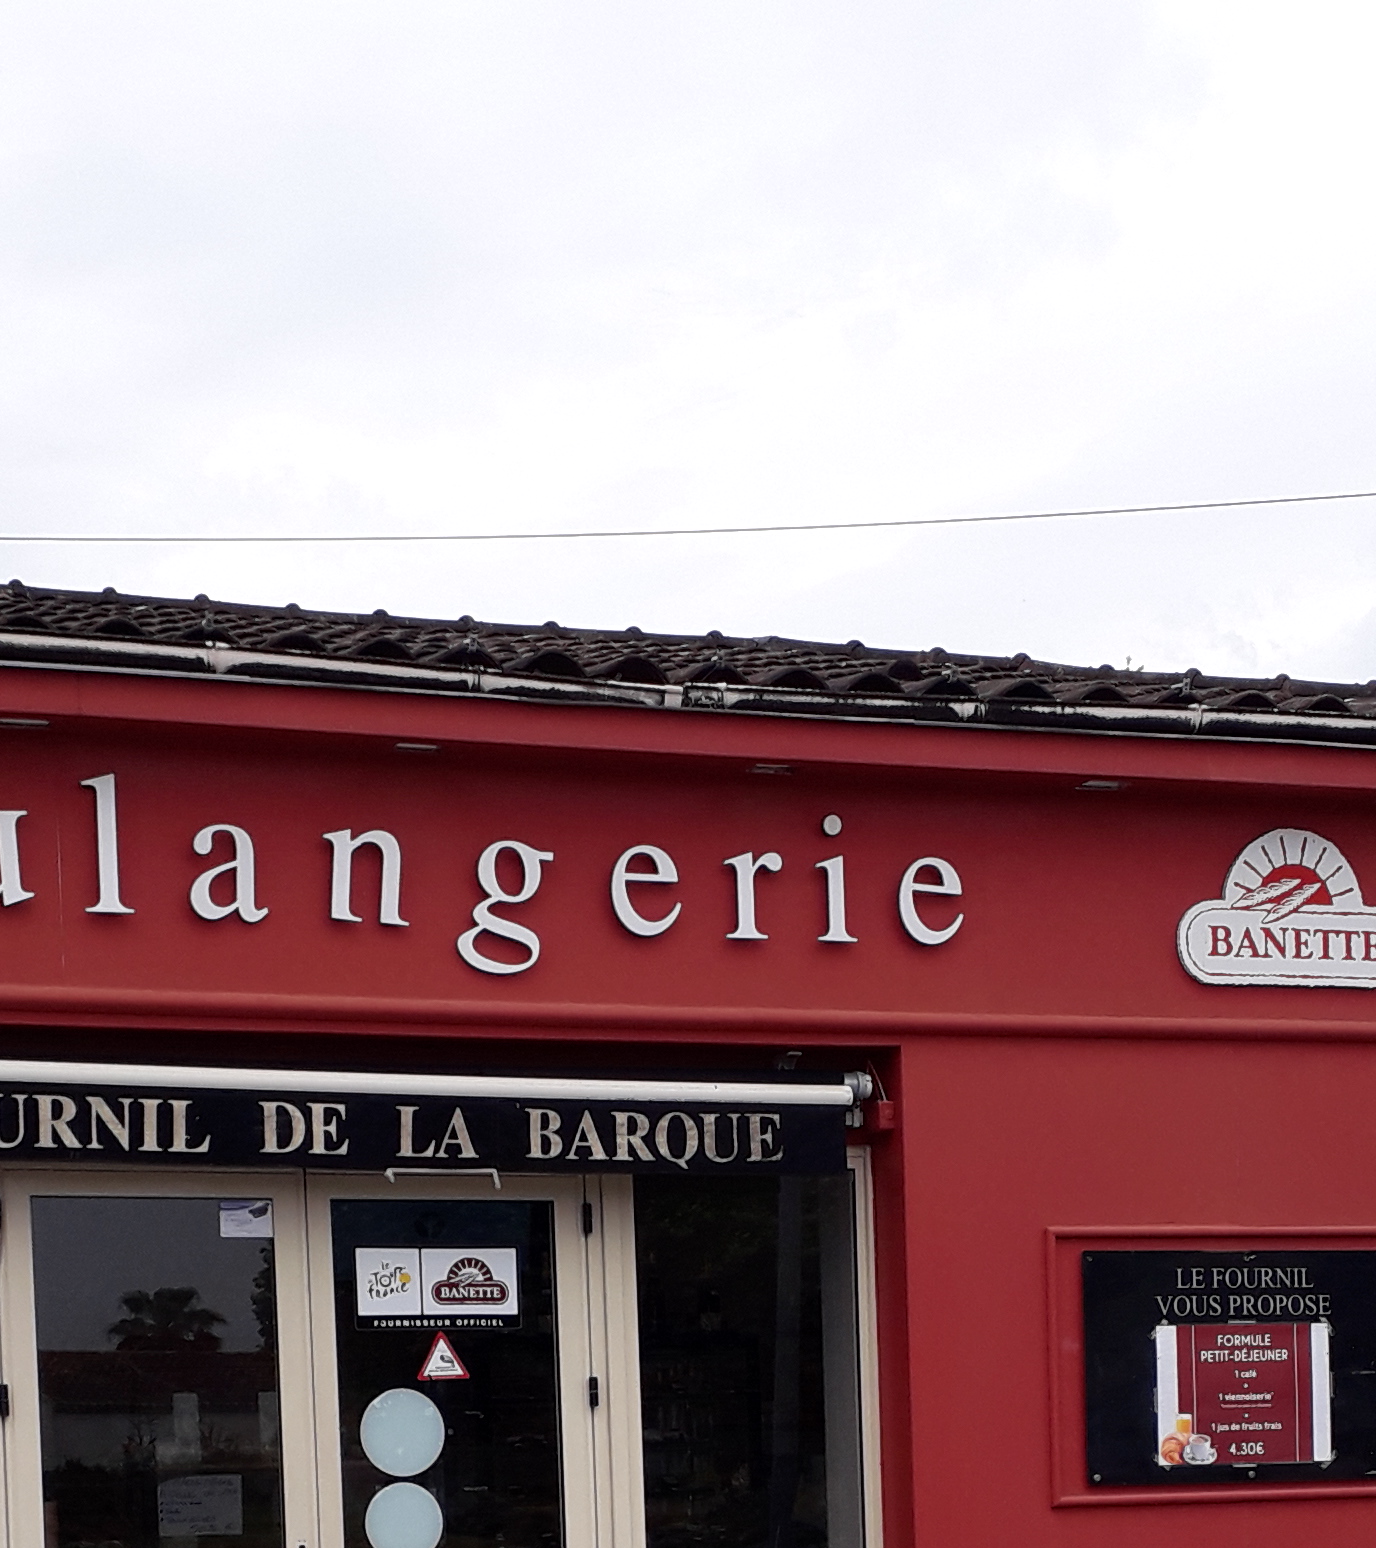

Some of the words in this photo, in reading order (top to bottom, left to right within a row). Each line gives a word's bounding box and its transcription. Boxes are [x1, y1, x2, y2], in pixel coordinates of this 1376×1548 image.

[259, 1100, 350, 1156] DE
[395, 1105, 480, 1159] LA
[525, 1107, 784, 1169] BARQUE
[1176, 1268, 1205, 1289] LE
[1211, 1267, 1314, 1289] FOURNIL
[440, 1286, 501, 1299] BANETTE
[1155, 1295, 1222, 1318] VOUS
[1228, 1294, 1332, 1317] PROPOSE
[374, 1319, 451, 1327] FOURNISSEUR
[456, 1318, 504, 1327] OFFICIEL
[1217, 1334, 1272, 1347] FORMULE
[1200, 1348, 1288, 1363] PETIT-DÉJEUNER
[1229, 1441, 1265, 1456] 4.30€
